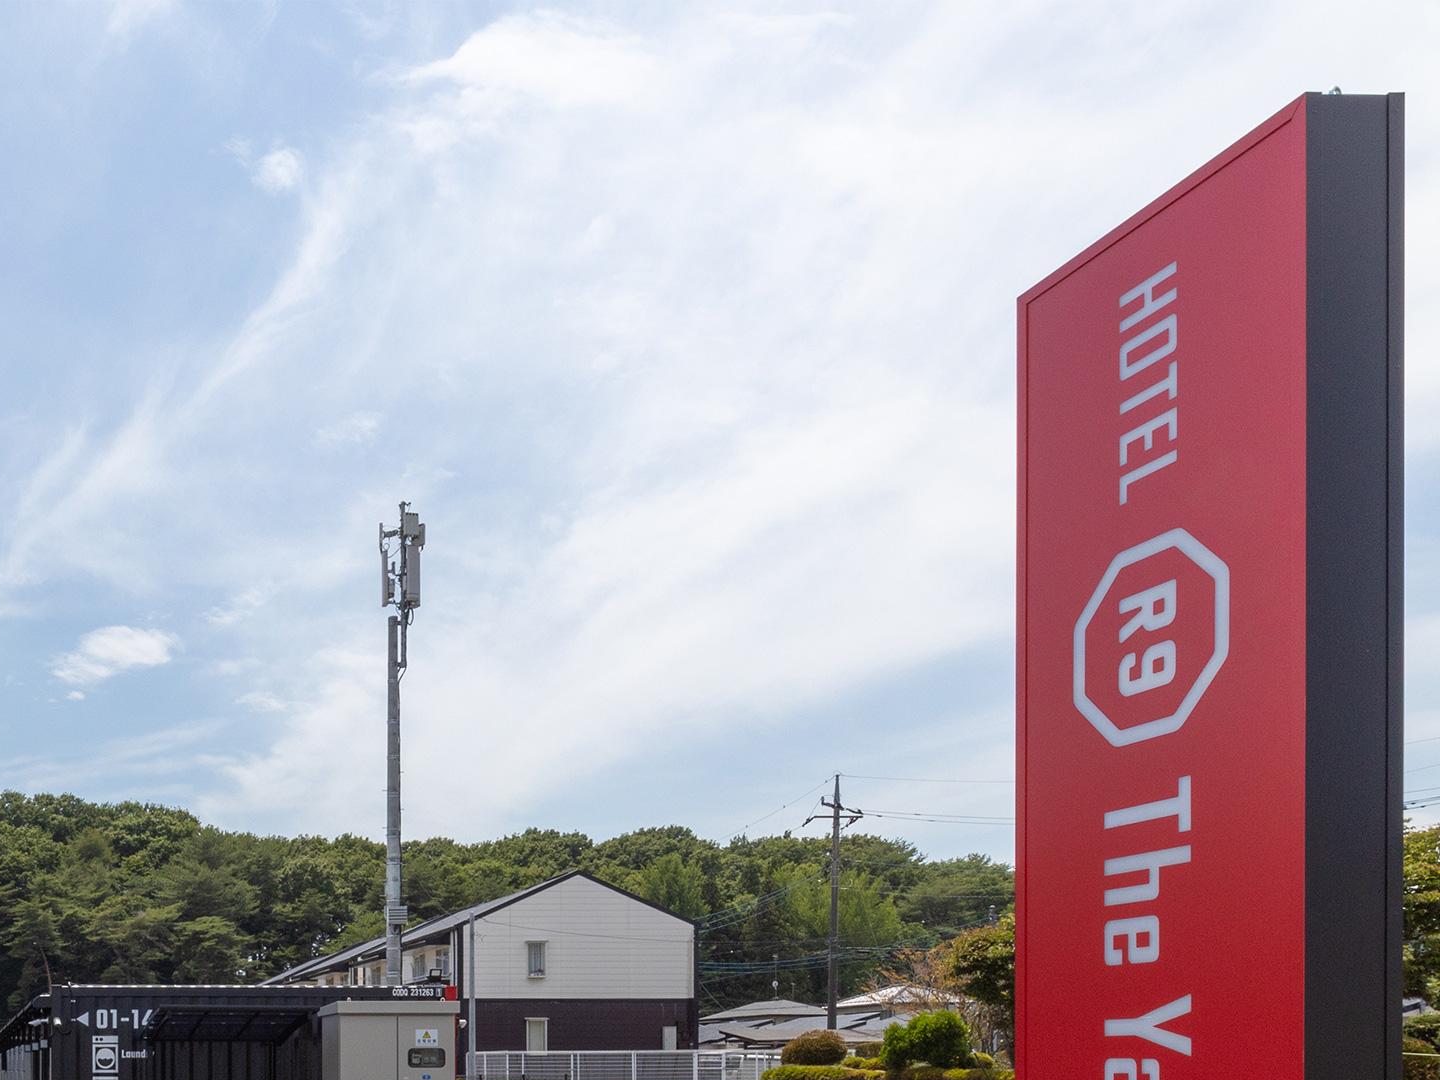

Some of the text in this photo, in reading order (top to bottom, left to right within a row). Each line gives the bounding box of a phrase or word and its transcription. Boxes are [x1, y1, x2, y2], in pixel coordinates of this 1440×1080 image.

[1118, 260, 1178, 507] HOTEL
[1118, 577, 1178, 698] R9
[1104, 775, 1192, 966] The
[410, 988, 434, 997] 231263
[121, 1049, 155, 1058] Laund
